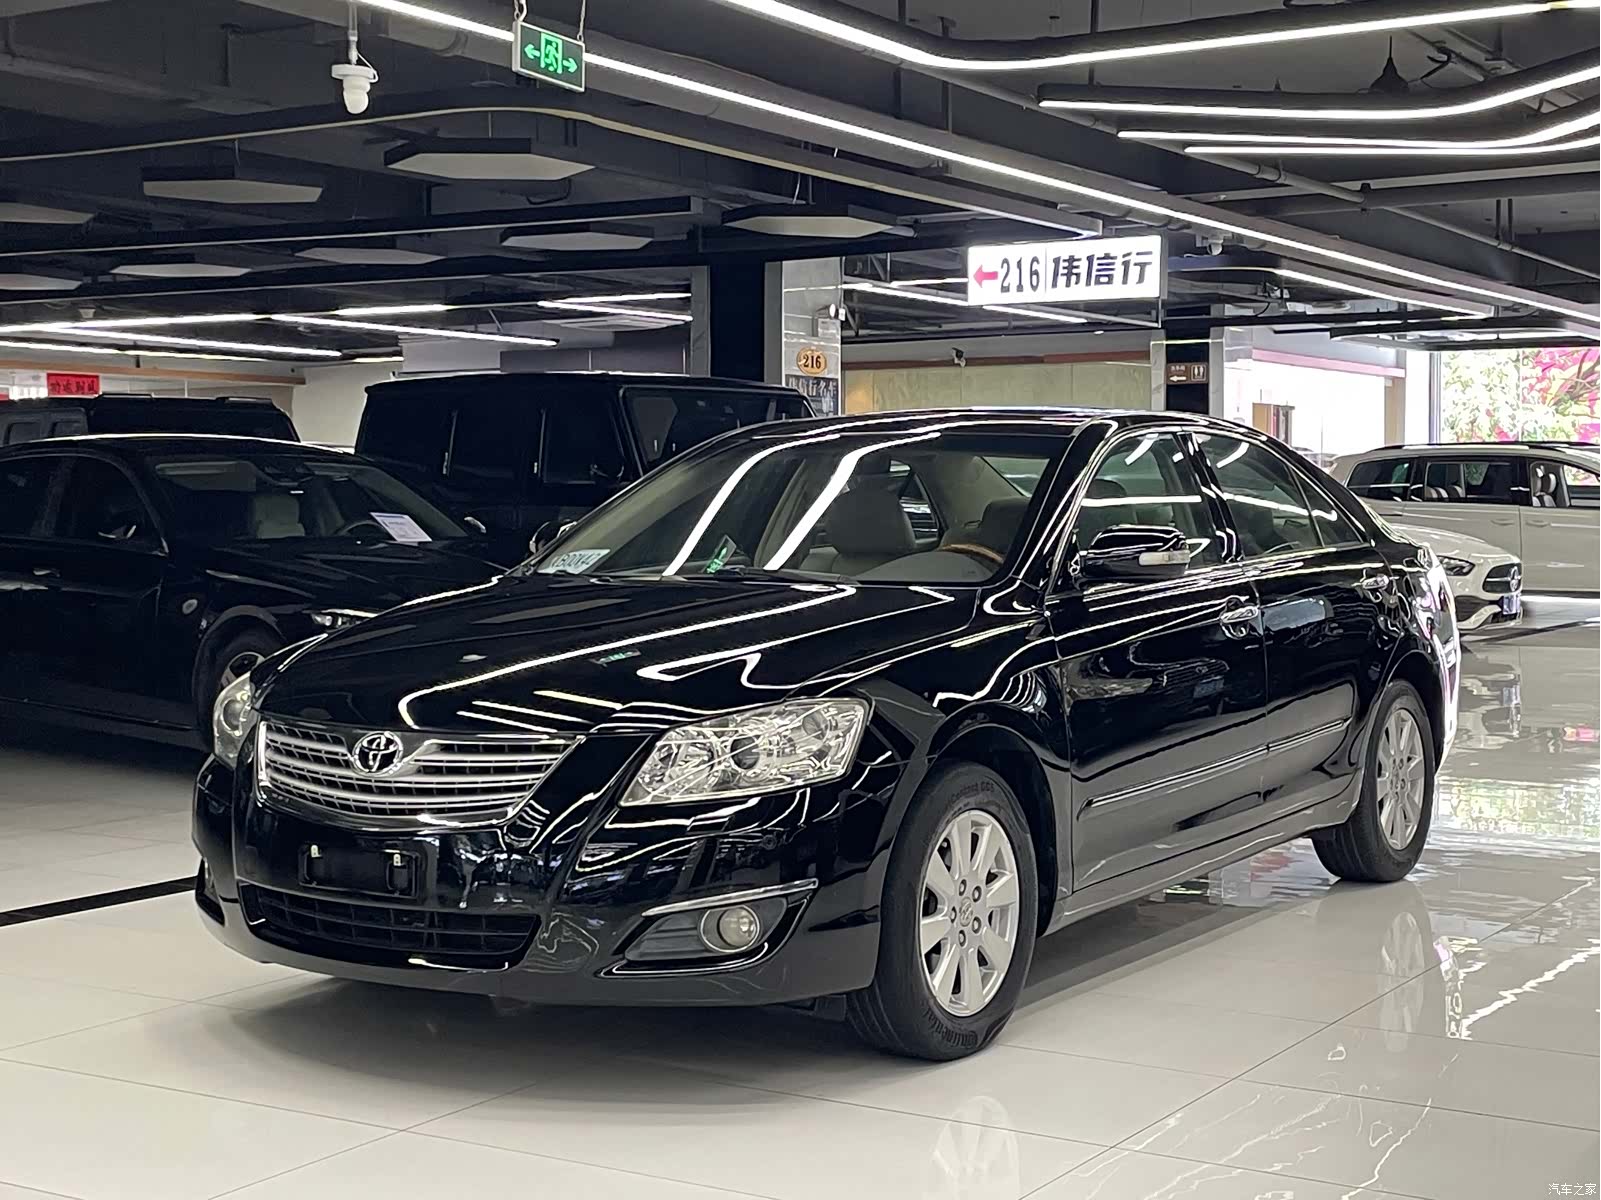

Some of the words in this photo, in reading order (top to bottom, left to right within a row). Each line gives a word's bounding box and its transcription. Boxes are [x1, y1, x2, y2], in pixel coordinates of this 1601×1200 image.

[1000, 255, 1040, 293] 216
[1051, 251, 1153, 289] 伟信行
[803, 354, 822, 370] 216
